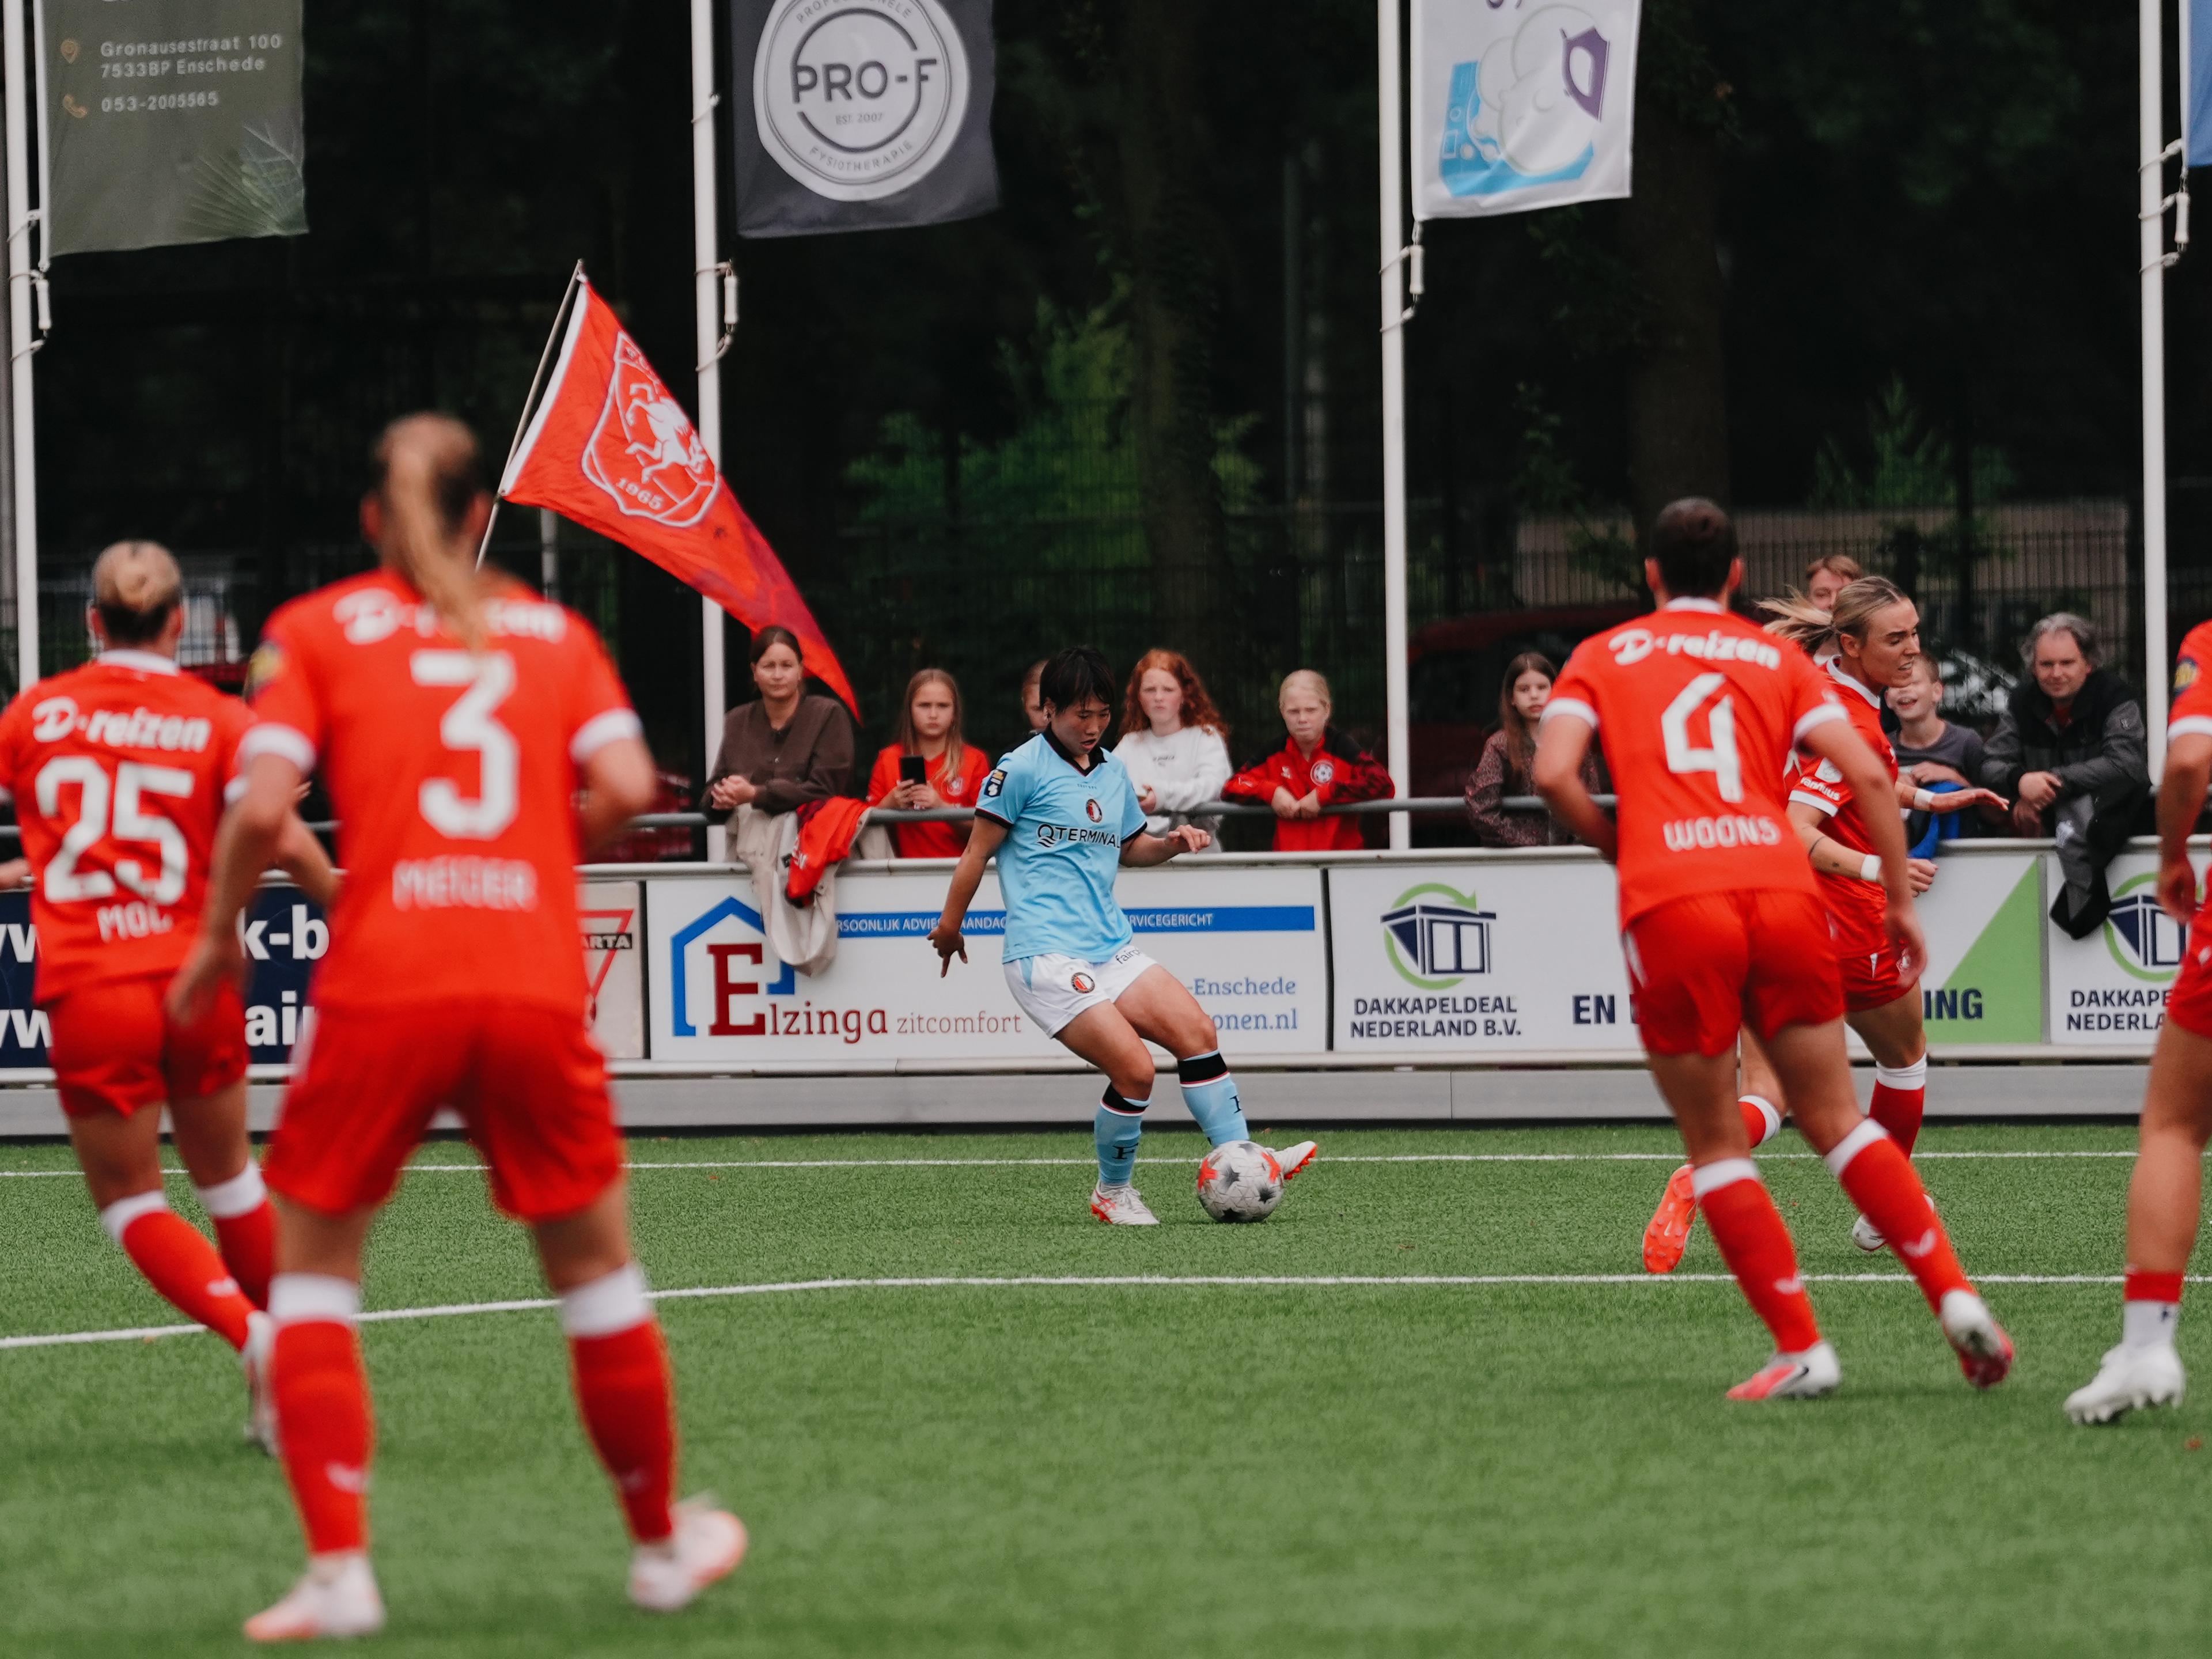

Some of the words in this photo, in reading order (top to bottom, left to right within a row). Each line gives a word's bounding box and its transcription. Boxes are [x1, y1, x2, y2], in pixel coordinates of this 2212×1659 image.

[248, 33, 282, 49] 100
[100, 59, 171, 78] 7533BP
[176, 56, 266, 75] Enschede
[791, 59, 937, 104] PRO-F
[809, 140, 913, 171] FYSIOTHERAPIE
[616, 478, 662, 510] 1965
[410, 649, 518, 839] 3
[1661, 673, 1742, 803] 4
[35, 756, 195, 904] 25
[1663, 815, 1781, 851] WOONS
[707, 943, 888, 1044] Elzinga
[897, 1010, 1021, 1033] zitcomfort
[1354, 995, 1517, 1016] DAKKAPELDEAL
[1573, 995, 1615, 1024] EN
[1350, 1020, 1477, 1038] NEDERLAND
[1484, 1018, 1521, 1036] B.V.
